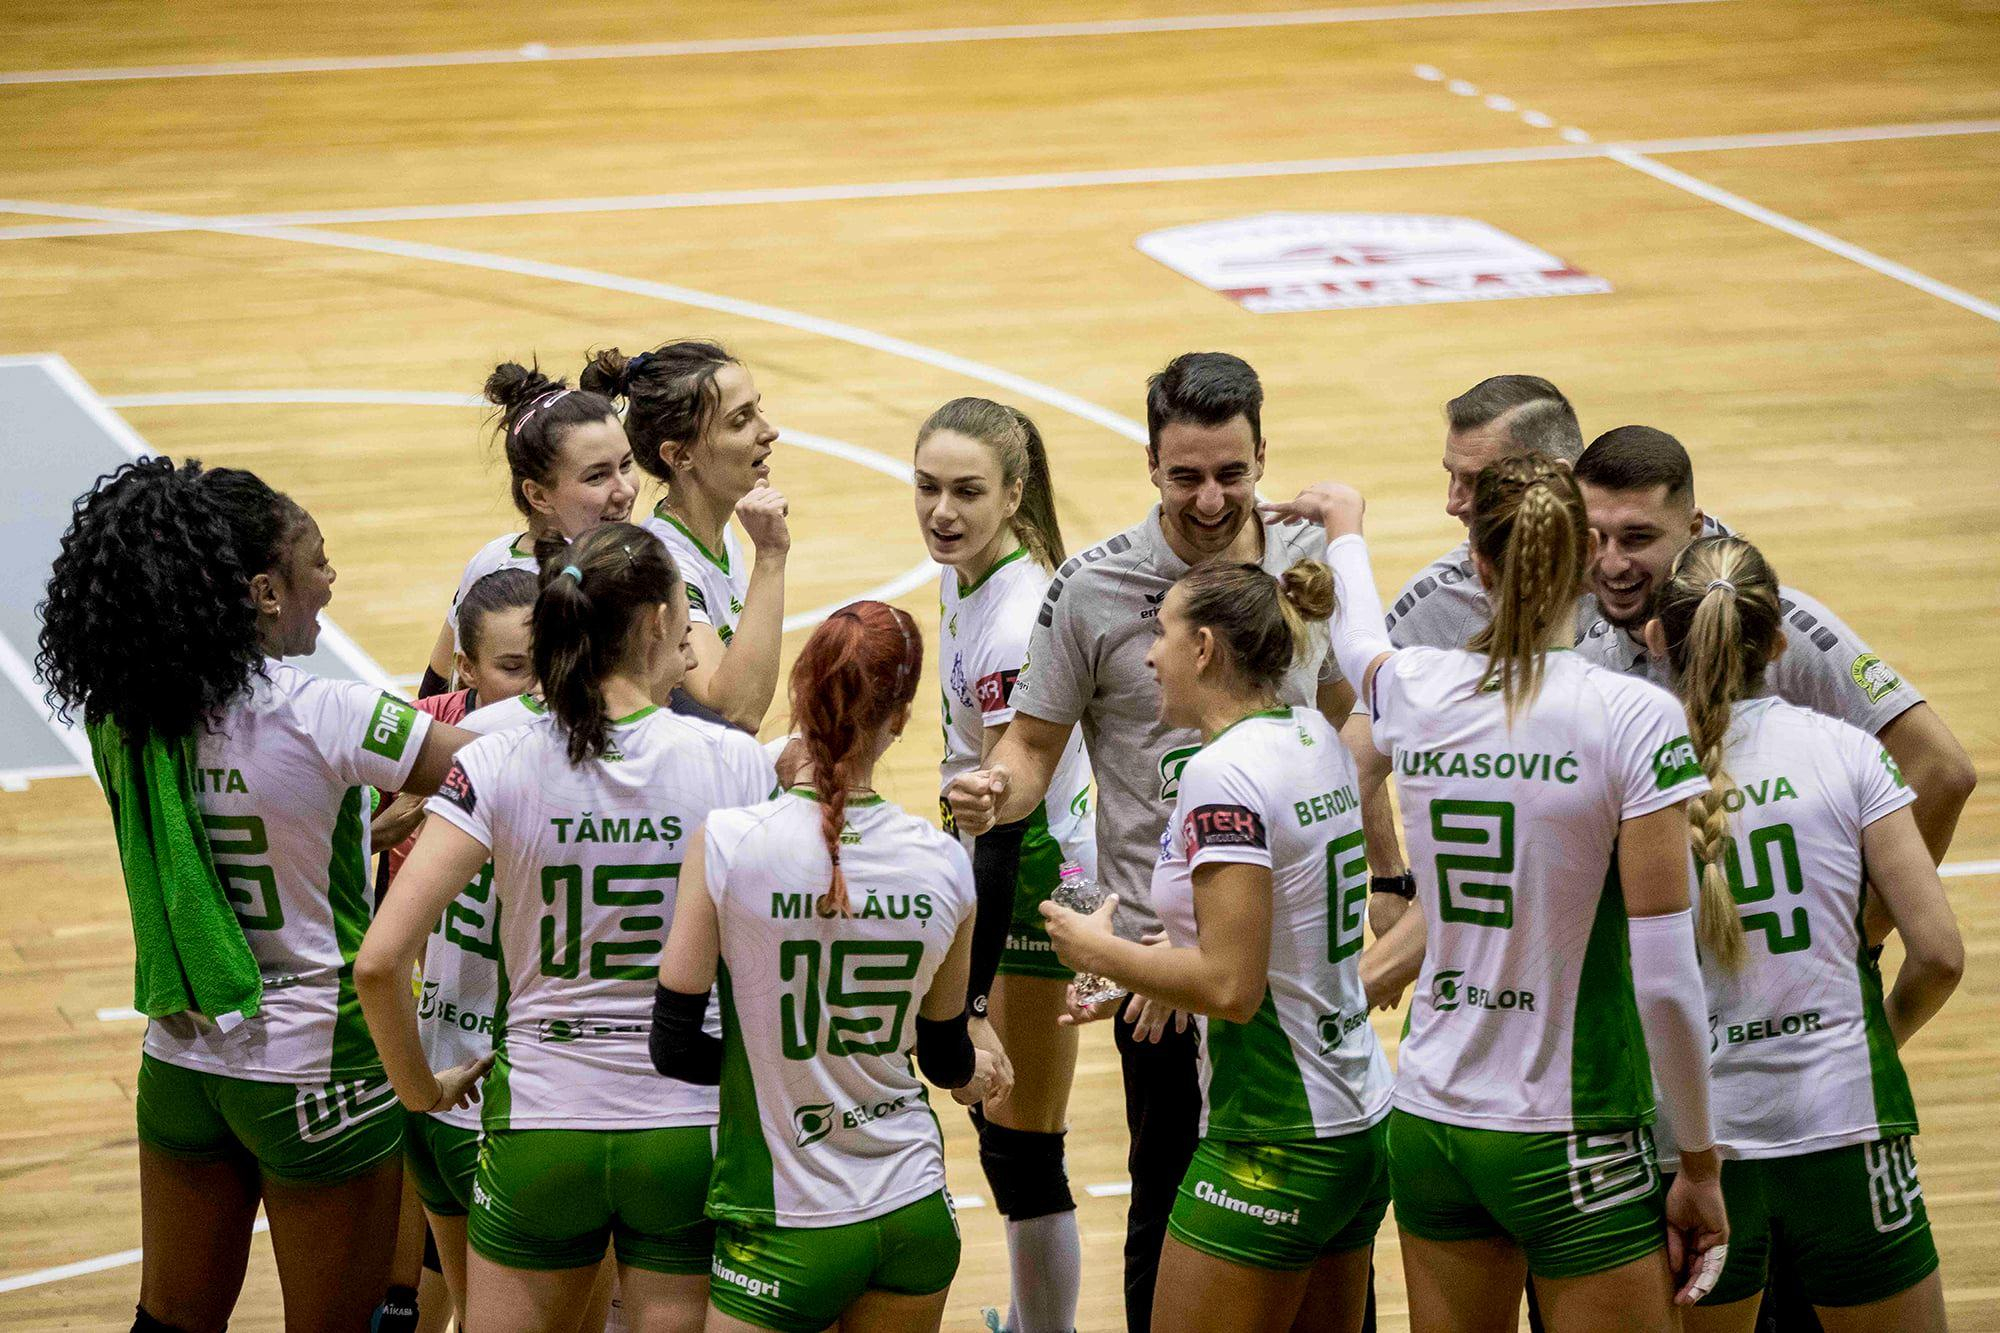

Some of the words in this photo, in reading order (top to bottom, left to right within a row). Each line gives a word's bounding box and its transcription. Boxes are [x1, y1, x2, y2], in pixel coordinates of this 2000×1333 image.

[193, 768, 250, 794] ITA
[551, 811, 683, 850] TĂMAȘ
[1430, 799, 1514, 930] 2
[771, 888, 933, 929] MICĂUȘ
[437, 1000, 495, 1035] EOR
[780, 940, 925, 1061] 15
[1726, 1011, 1824, 1045] BELOR
[1194, 1180, 1300, 1226] Chimagri
